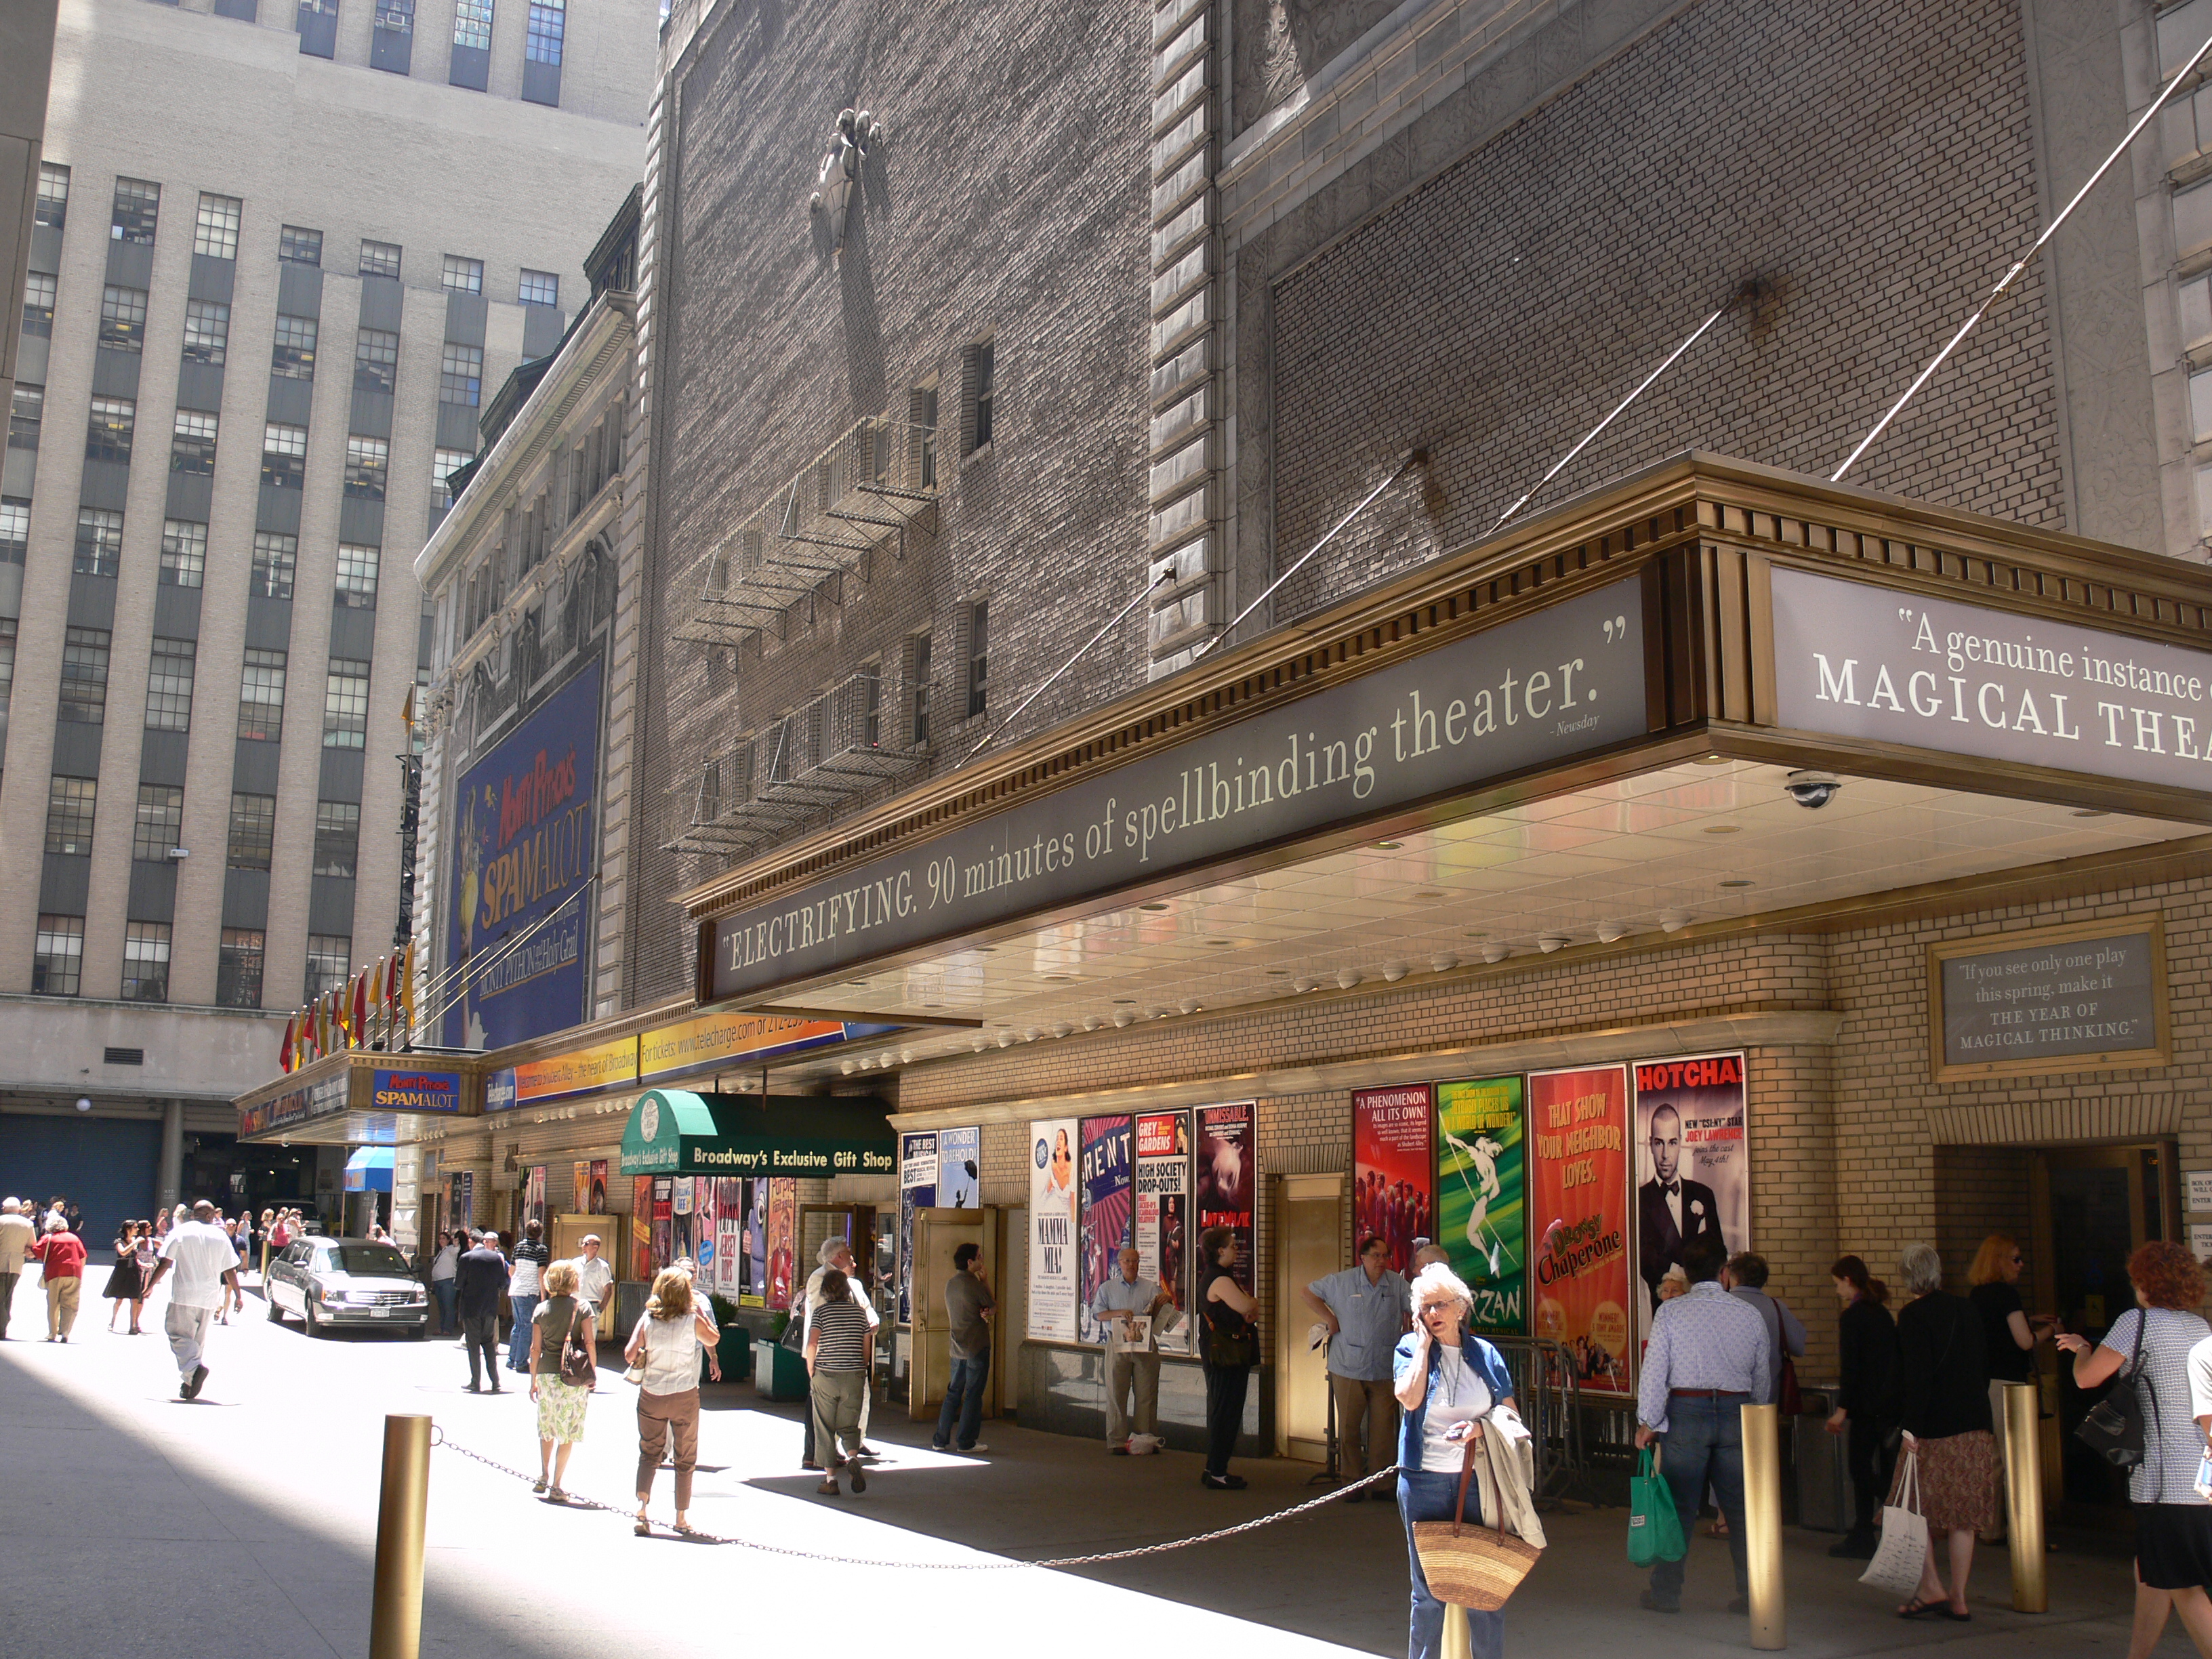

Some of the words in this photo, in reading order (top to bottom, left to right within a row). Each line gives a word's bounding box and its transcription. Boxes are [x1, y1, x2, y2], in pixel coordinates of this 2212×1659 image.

[1898, 607, 1940, 655] "A
[1946, 632, 2074, 677] genuine
[2081, 646, 2202, 701] instance
[1813, 653, 2078, 741] MAGICAL
[1557, 714, 1600, 737] Newsday
[497, 774, 535, 850] MONTY
[722, 868, 918, 972] "ELECTRIFYING.
[927, 855, 955, 910] 90
[964, 832, 1074, 899] minutes
[1084, 798, 1116, 861] of
[1124, 724, 1377, 863] spellbinding
[482, 800, 588, 930] SPAMALOT
[505, 945, 535, 985] PYTHON
[541, 928, 560, 975] Holy
[560, 919, 577, 962] Grail
[1978, 966, 2002, 984] you
[2005, 962, 2028, 976] see
[2032, 954, 2062, 975] only
[2066, 954, 2092, 968] one
[2096, 947, 2127, 970] play
[1975, 987, 2001, 1003] this
[2005, 982, 2055, 1004] spring,
[2059, 975, 2097, 994] make
[2102, 973, 2113, 989] it
[1990, 1010, 2023, 1025] THE
[2028, 1006, 2071, 1021] YEAR
[2076, 1002, 2097, 1017] OF
[642, 1044, 651, 1062] For
[653, 1041, 676, 1060] tickets:
[678, 1021, 755, 1054] www.telecharge.com
[757, 1021, 766, 1035] or
[1960, 1030, 2033, 1049] MAGICAL
[2039, 1019, 2137, 1042] THINKING."
[562, 1064, 574, 1084] Alley
[578, 1061, 587, 1077] the
[587, 1058, 601, 1076] heart
[602, 1054, 609, 1072] of
[609, 1050, 638, 1072] Broadway
[1637, 1058, 1743, 1092] HOTCHA!
[389, 1073, 417, 1089] MONTY
[375, 1090, 457, 1108] SPAMALOT
[1367, 1091, 1426, 1109] PHENOMENON
[1548, 1101, 1572, 1128] THAT
[1574, 1092, 1607, 1123] SHOW
[1372, 1109, 1385, 1122] ALL
[1388, 1107, 1400, 1120] ITS
[1402, 1106, 1427, 1120] OWN!
[1685, 1120, 1698, 1130] NEW
[1727, 1116, 1742, 1126] STAR
[943, 1133, 947, 1147] A
[949, 1130, 975, 1145] WONDER
[1139, 1121, 1158, 1137] GREY
[1685, 1130, 1703, 1143] JOEY
[1704, 1127, 1743, 1142] LAWRENCE
[922, 1139, 935, 1150] BEST
[1139, 1136, 1171, 1152] GARDENS
[1536, 1133, 1563, 1160] YOUR
[1565, 1124, 1622, 1157] NEIGHBOR
[1708, 1143, 1719, 1152] the
[1720, 1143, 1734, 1152] cast
[694, 1147, 768, 1170] Broadway's
[773, 1150, 827, 1167] Exclusive
[834, 1151, 857, 1167] Gift
[863, 1151, 893, 1171] Shop
[941, 1150, 948, 1164] TO
[949, 1148, 977, 1164] BEHOLD!
[1084, 1132, 1131, 1183] RENT
[1700, 1155, 1715, 1168] May
[1715, 1154, 1729, 1164] 4th!
[903, 1168, 916, 1185] BEST
[1139, 1163, 1154, 1178] HIGH
[1156, 1162, 1187, 1177] SOCIETY
[1563, 1158, 1597, 1189] LOVES.
[1139, 1176, 1181, 1193] DROP-OUTS!
[1038, 1218, 1068, 1245] MAMMA
[1044, 1246, 1062, 1274] MIA!
[1538, 1231, 1622, 1286] Chaperone
